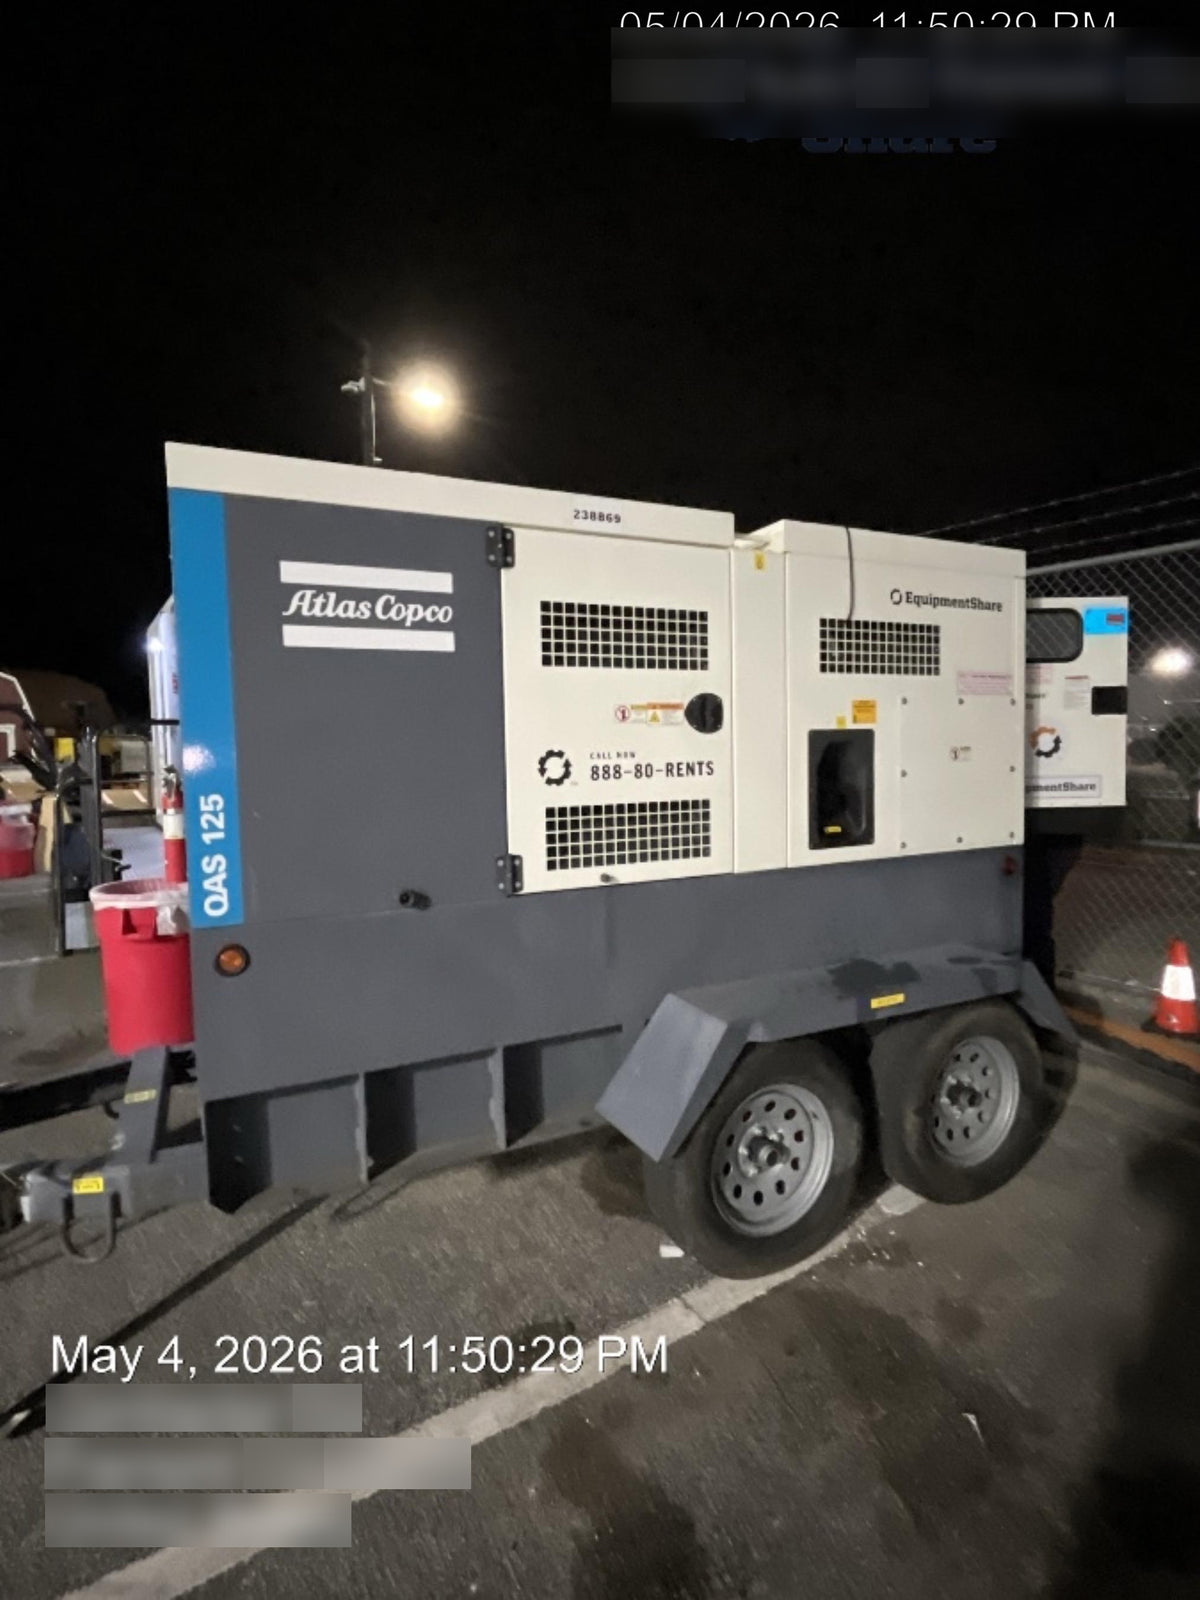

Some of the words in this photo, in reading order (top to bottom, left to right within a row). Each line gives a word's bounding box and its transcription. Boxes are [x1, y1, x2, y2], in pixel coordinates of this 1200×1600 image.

[573, 509, 622, 523] 238869
[282, 589, 372, 619] Atlas
[375, 594, 453, 627] Copco
[905, 591, 1003, 612] EquipmentShare
[590, 760, 715, 781] 888-80-RENTS
[1024, 782, 1096, 794] pmentShare
[199, 793, 225, 845] 125
[201, 853, 229, 917] QAS
